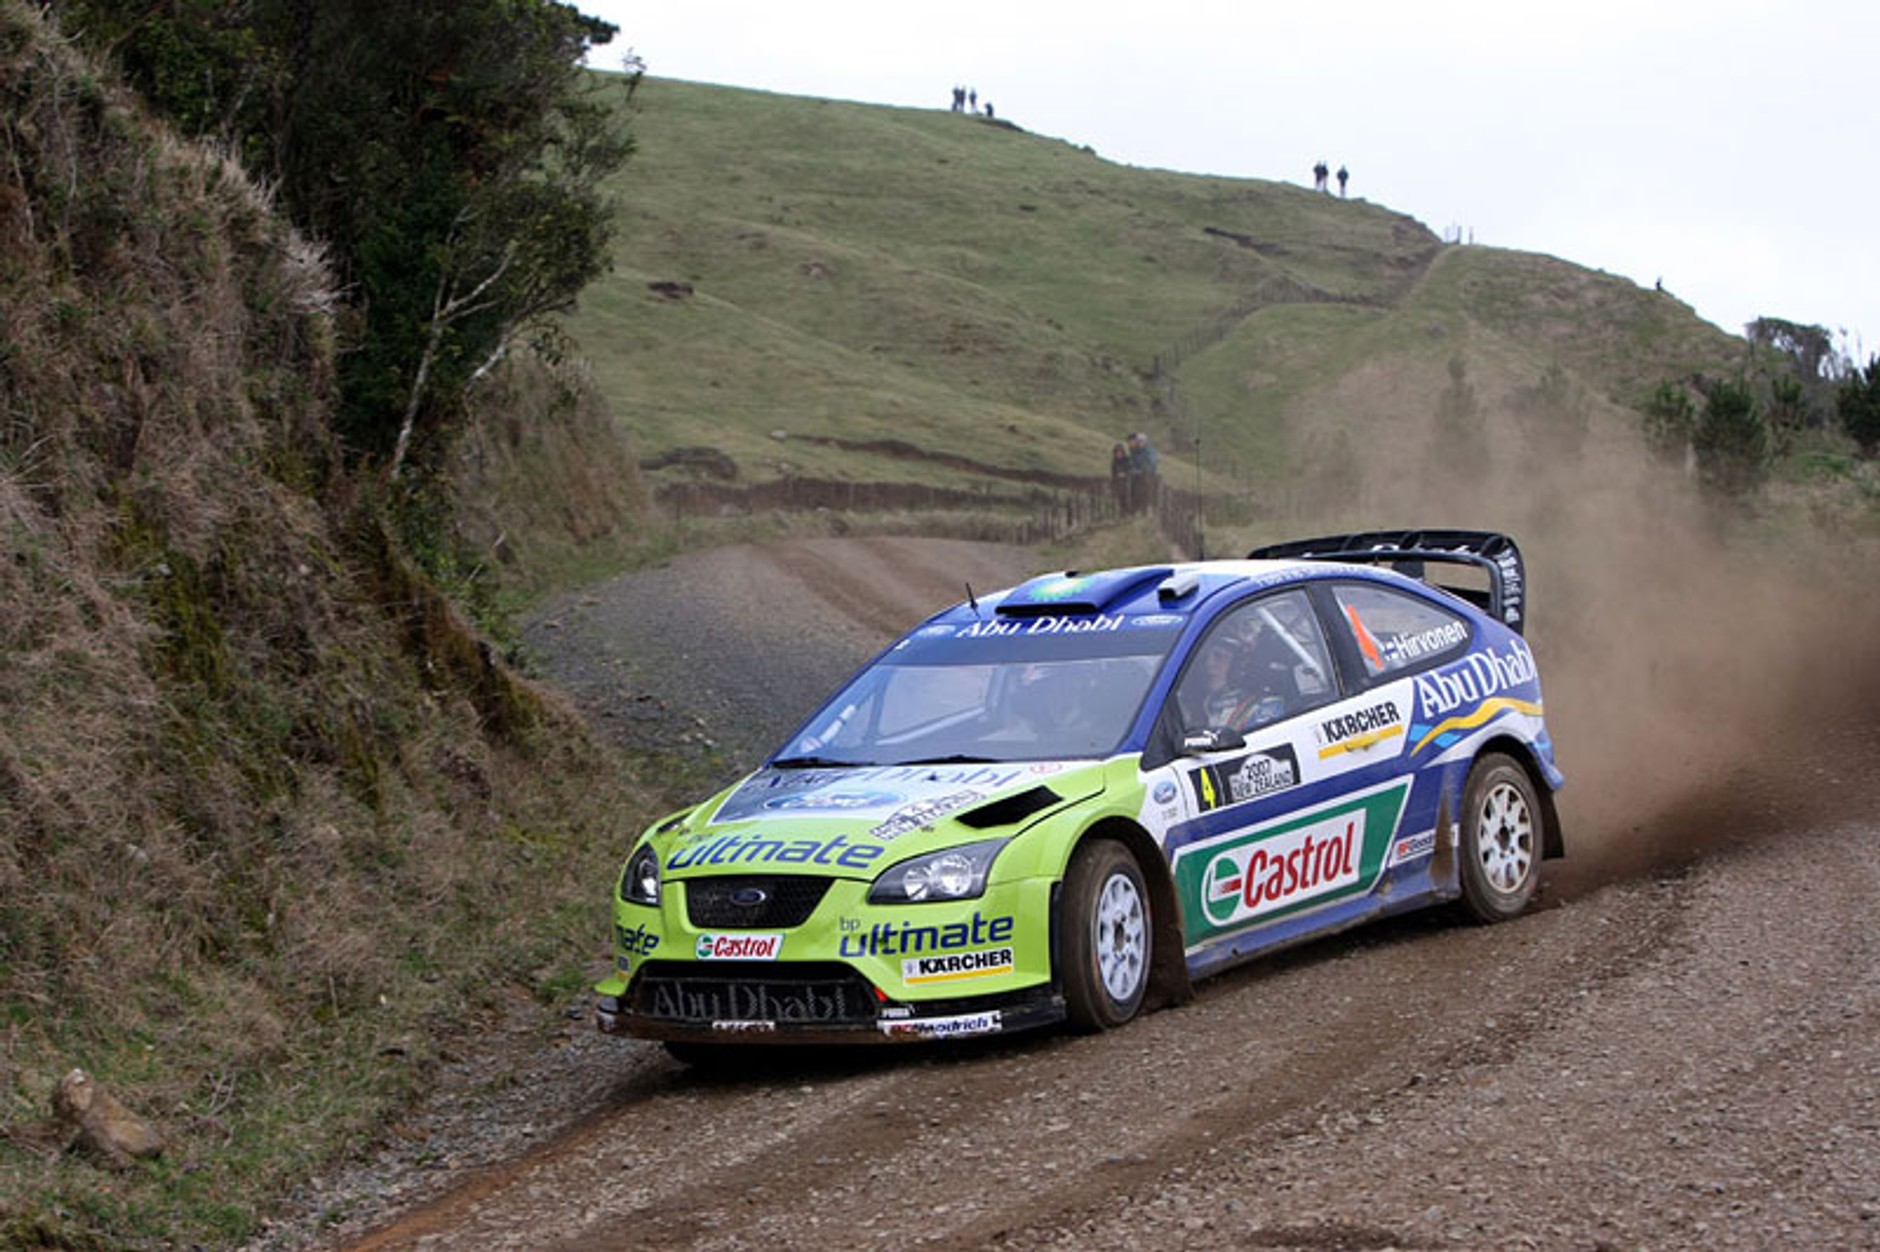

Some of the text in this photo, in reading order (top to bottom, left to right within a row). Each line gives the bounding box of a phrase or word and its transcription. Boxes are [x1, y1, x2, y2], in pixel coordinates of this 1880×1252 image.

[956, 618, 1020, 638] Abu
[1395, 621, 1468, 659] Hirvonen
[1416, 668, 1476, 718] Abu
[1322, 701, 1400, 743] KÄRCHER
[1201, 768, 1216, 809] 4
[1245, 759, 1270, 780] 2007
[667, 834, 885, 869] ultimate
[1244, 822, 1354, 908] Castrol
[714, 936, 776, 957] Castrol
[839, 911, 1013, 958] ultimate
[652, 983, 721, 1020] Abu
